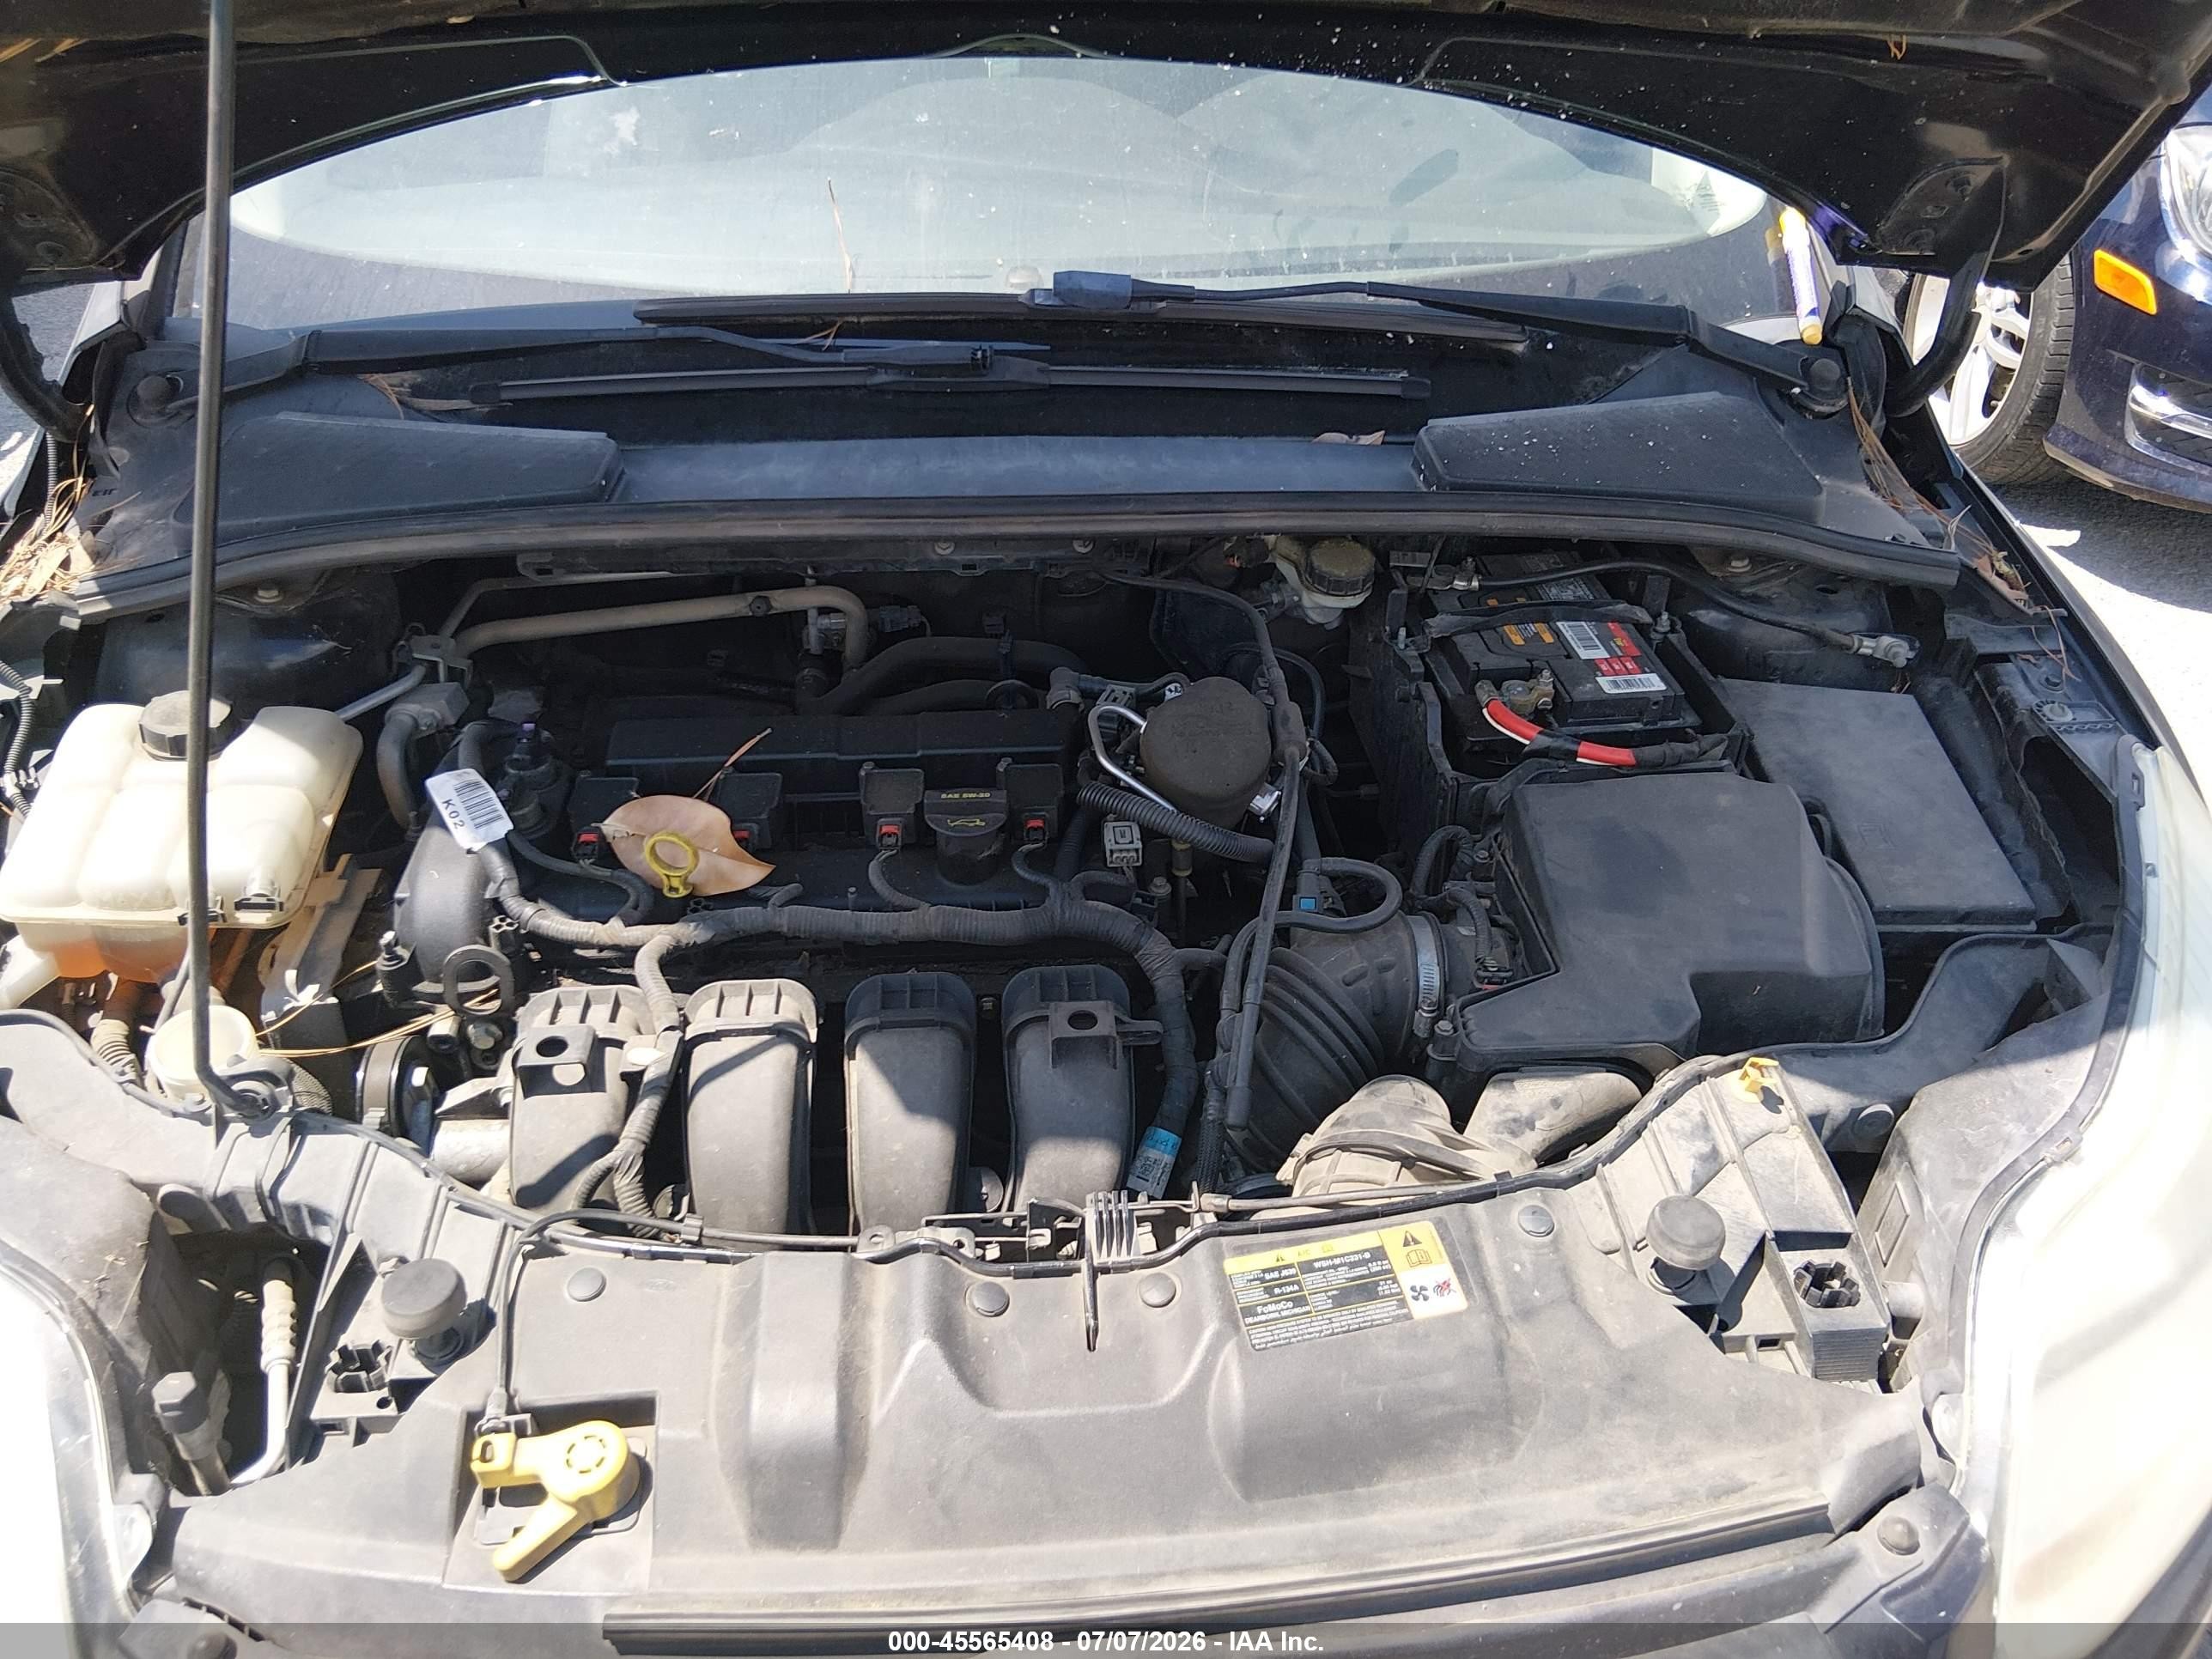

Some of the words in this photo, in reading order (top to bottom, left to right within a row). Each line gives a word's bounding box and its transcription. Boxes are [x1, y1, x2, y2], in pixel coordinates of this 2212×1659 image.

[442, 799, 465, 830] K02
[1273, 1284, 1300, 1295] R-134A
[1256, 1299, 1294, 1314] FoMoCo
